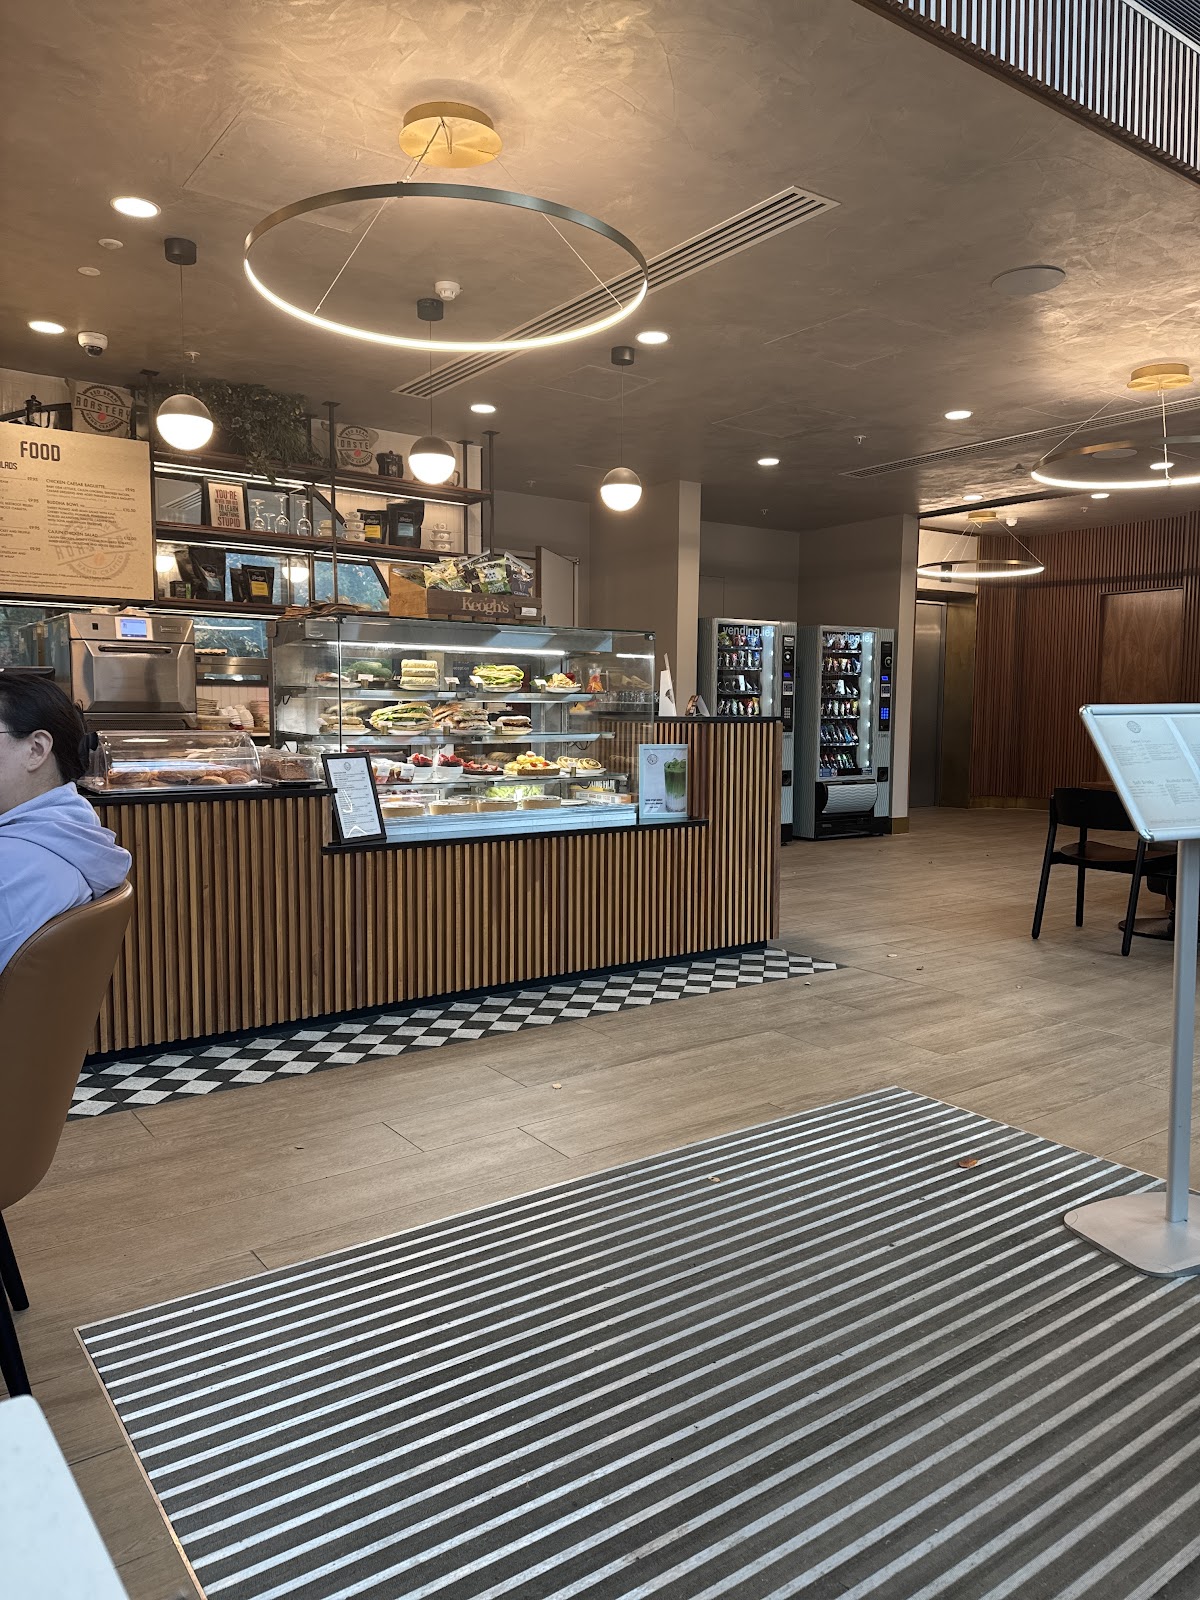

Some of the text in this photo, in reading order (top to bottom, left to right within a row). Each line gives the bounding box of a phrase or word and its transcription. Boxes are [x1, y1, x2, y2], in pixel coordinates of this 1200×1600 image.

[76, 396, 130, 420] ROASTERY
[20, 441, 61, 462] FOOD
[215, 489, 237, 500] YOU'RE
[218, 516, 240, 528] STUPID
[76, 562, 97, 575] HAND
[462, 596, 509, 615] Keogh's
[722, 626, 770, 638] vending.ie
